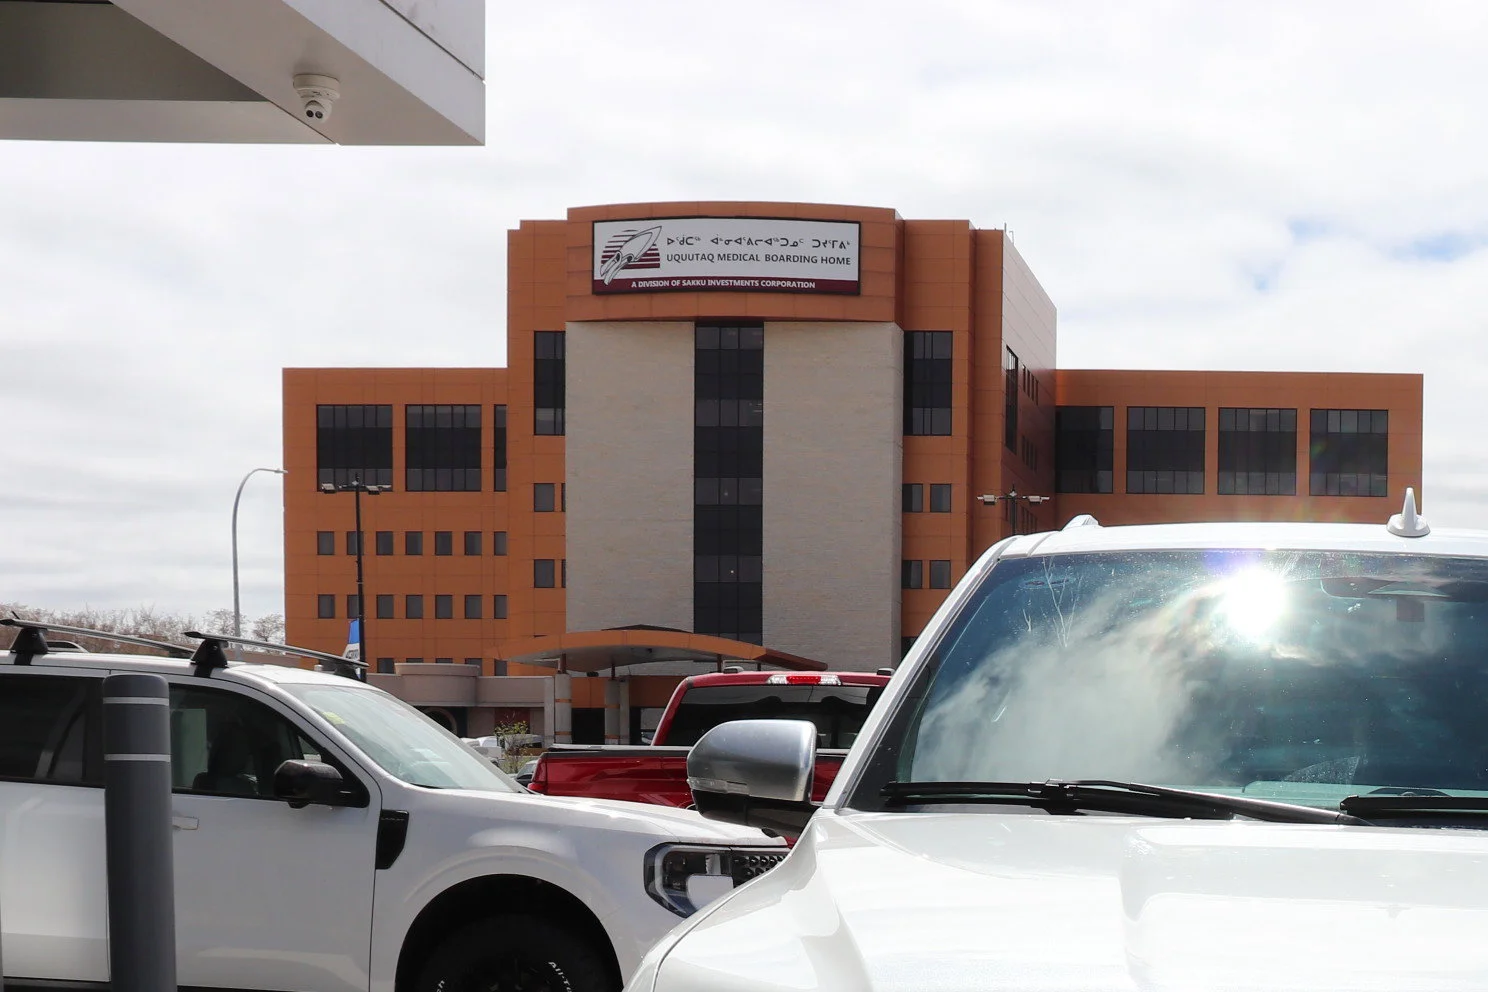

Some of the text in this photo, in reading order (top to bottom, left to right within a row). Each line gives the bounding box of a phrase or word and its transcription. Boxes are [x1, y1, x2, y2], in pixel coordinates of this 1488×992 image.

[666, 253, 851, 265] UQUUTAQ MEDICAL BOARDING HOME
[638, 280, 669, 288] DIVISION
[682, 279, 706, 287] SAKKU
[707, 279, 759, 288] INVESTMENTS
[761, 280, 816, 289] CORPORATION
